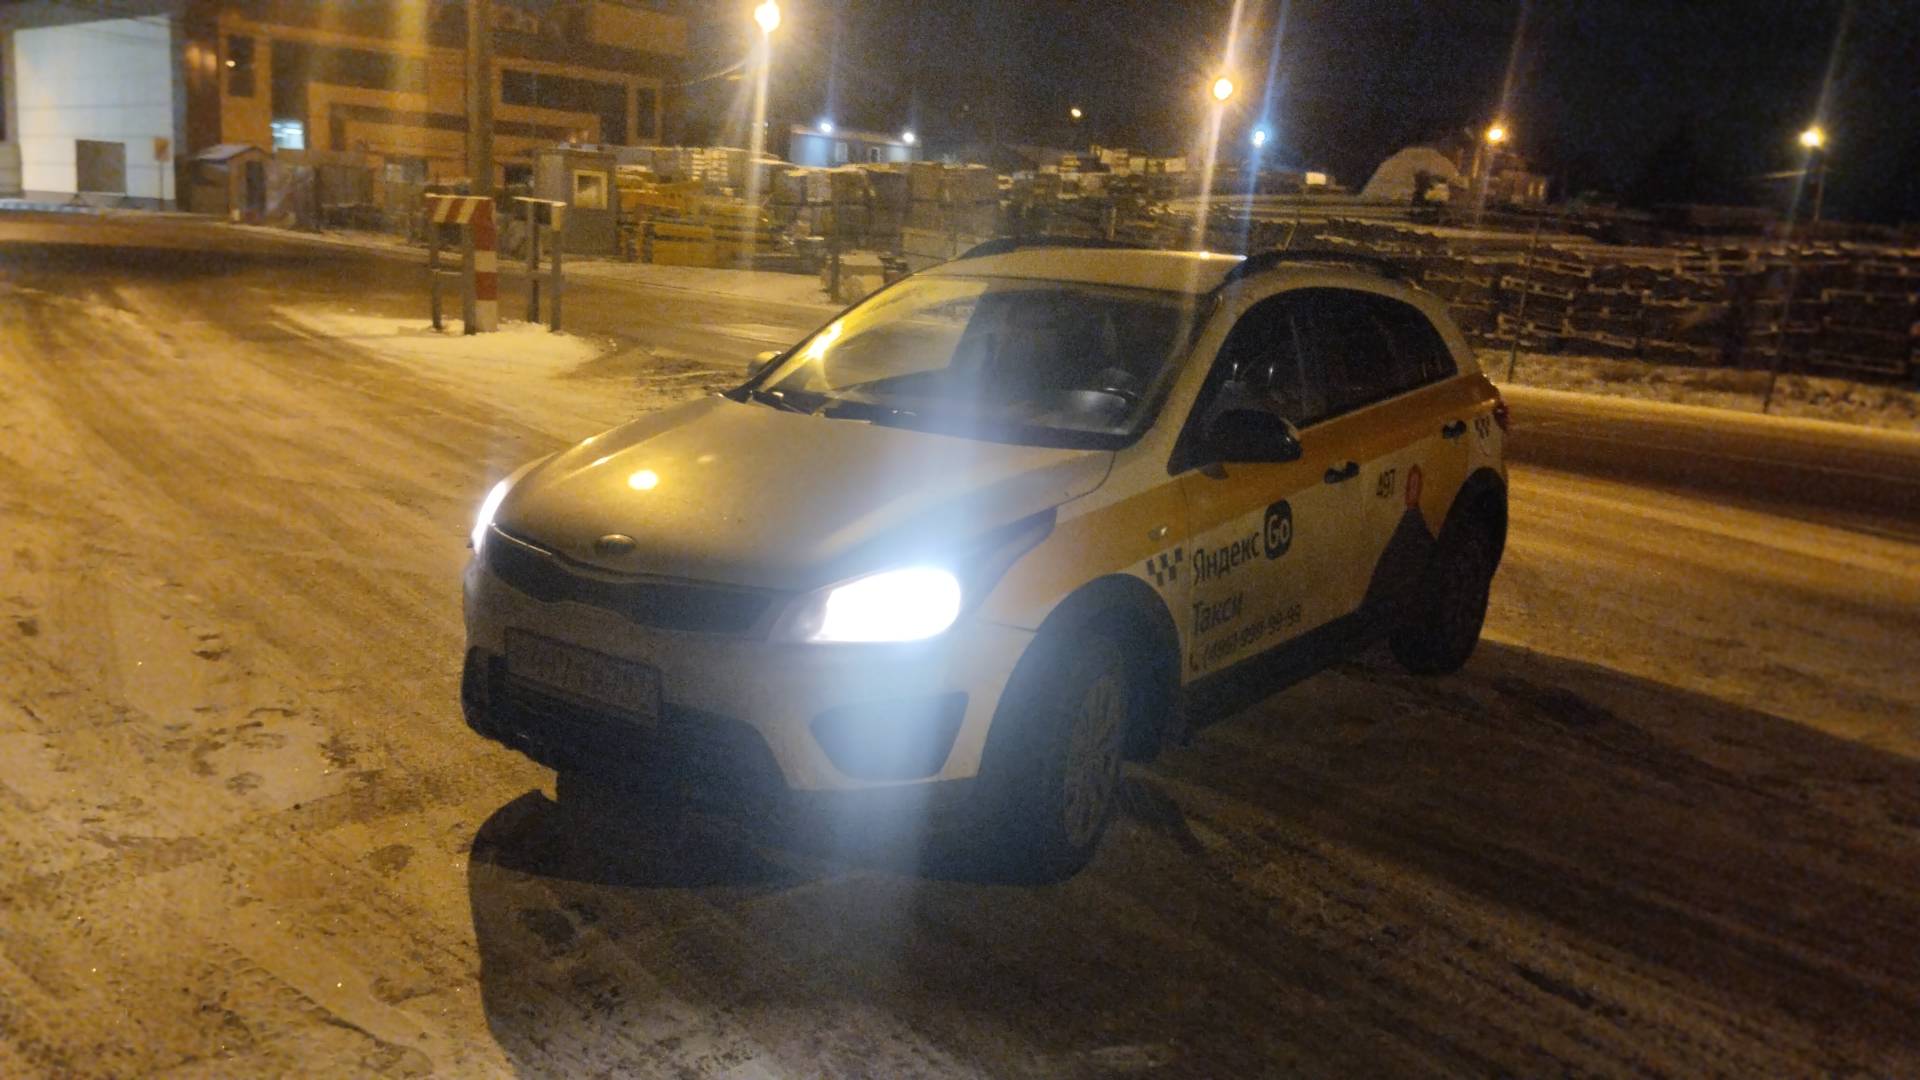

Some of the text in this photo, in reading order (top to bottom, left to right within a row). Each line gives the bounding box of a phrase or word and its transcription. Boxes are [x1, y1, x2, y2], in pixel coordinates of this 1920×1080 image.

[1192, 513, 1290, 587] Яндекс Go
[1192, 591, 1244, 636] Такси
